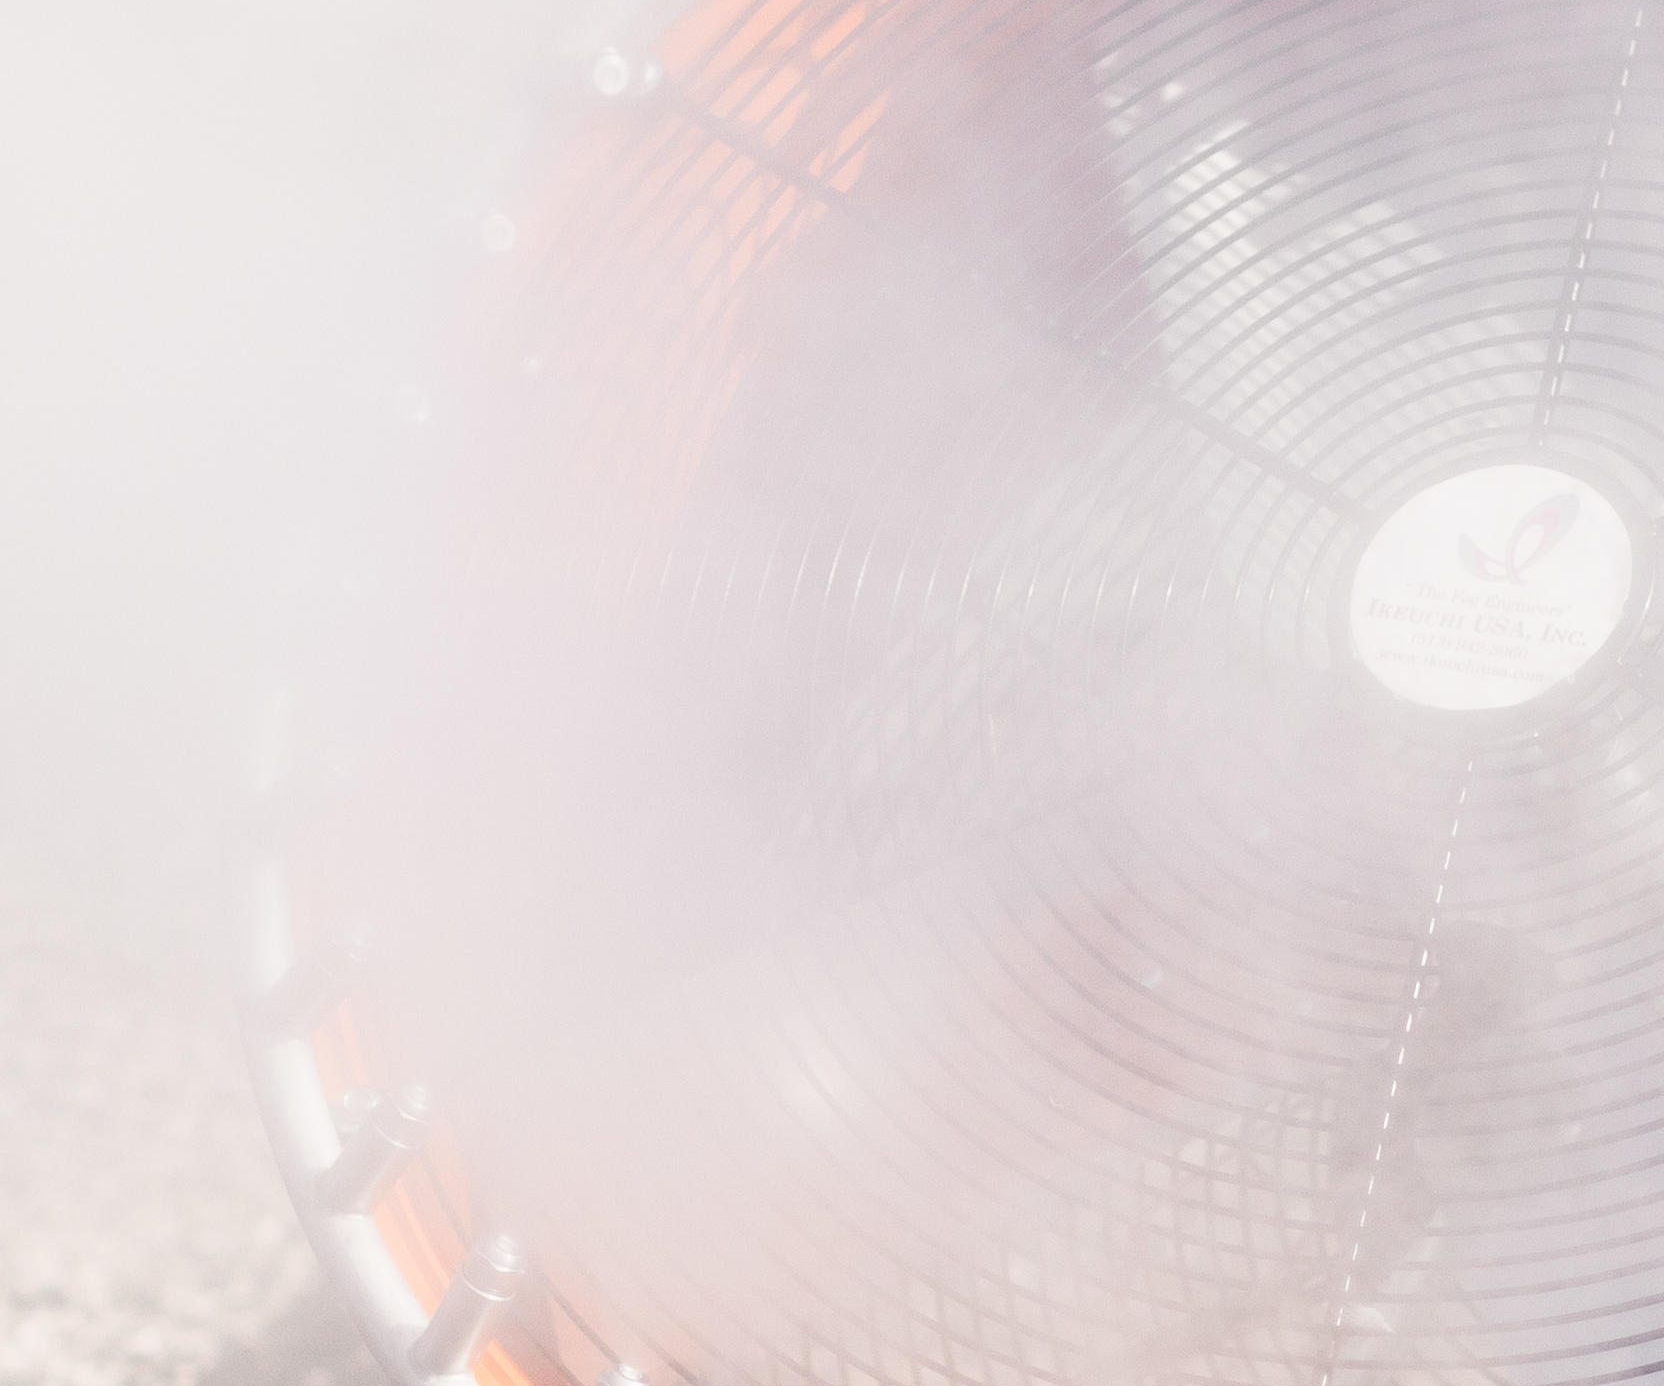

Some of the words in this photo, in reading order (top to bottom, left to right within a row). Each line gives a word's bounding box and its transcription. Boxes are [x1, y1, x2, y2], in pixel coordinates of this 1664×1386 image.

[1366, 597, 1467, 630] IKEUCHI
[1472, 613, 1532, 641] USA,
[1539, 623, 1588, 647] INC.
